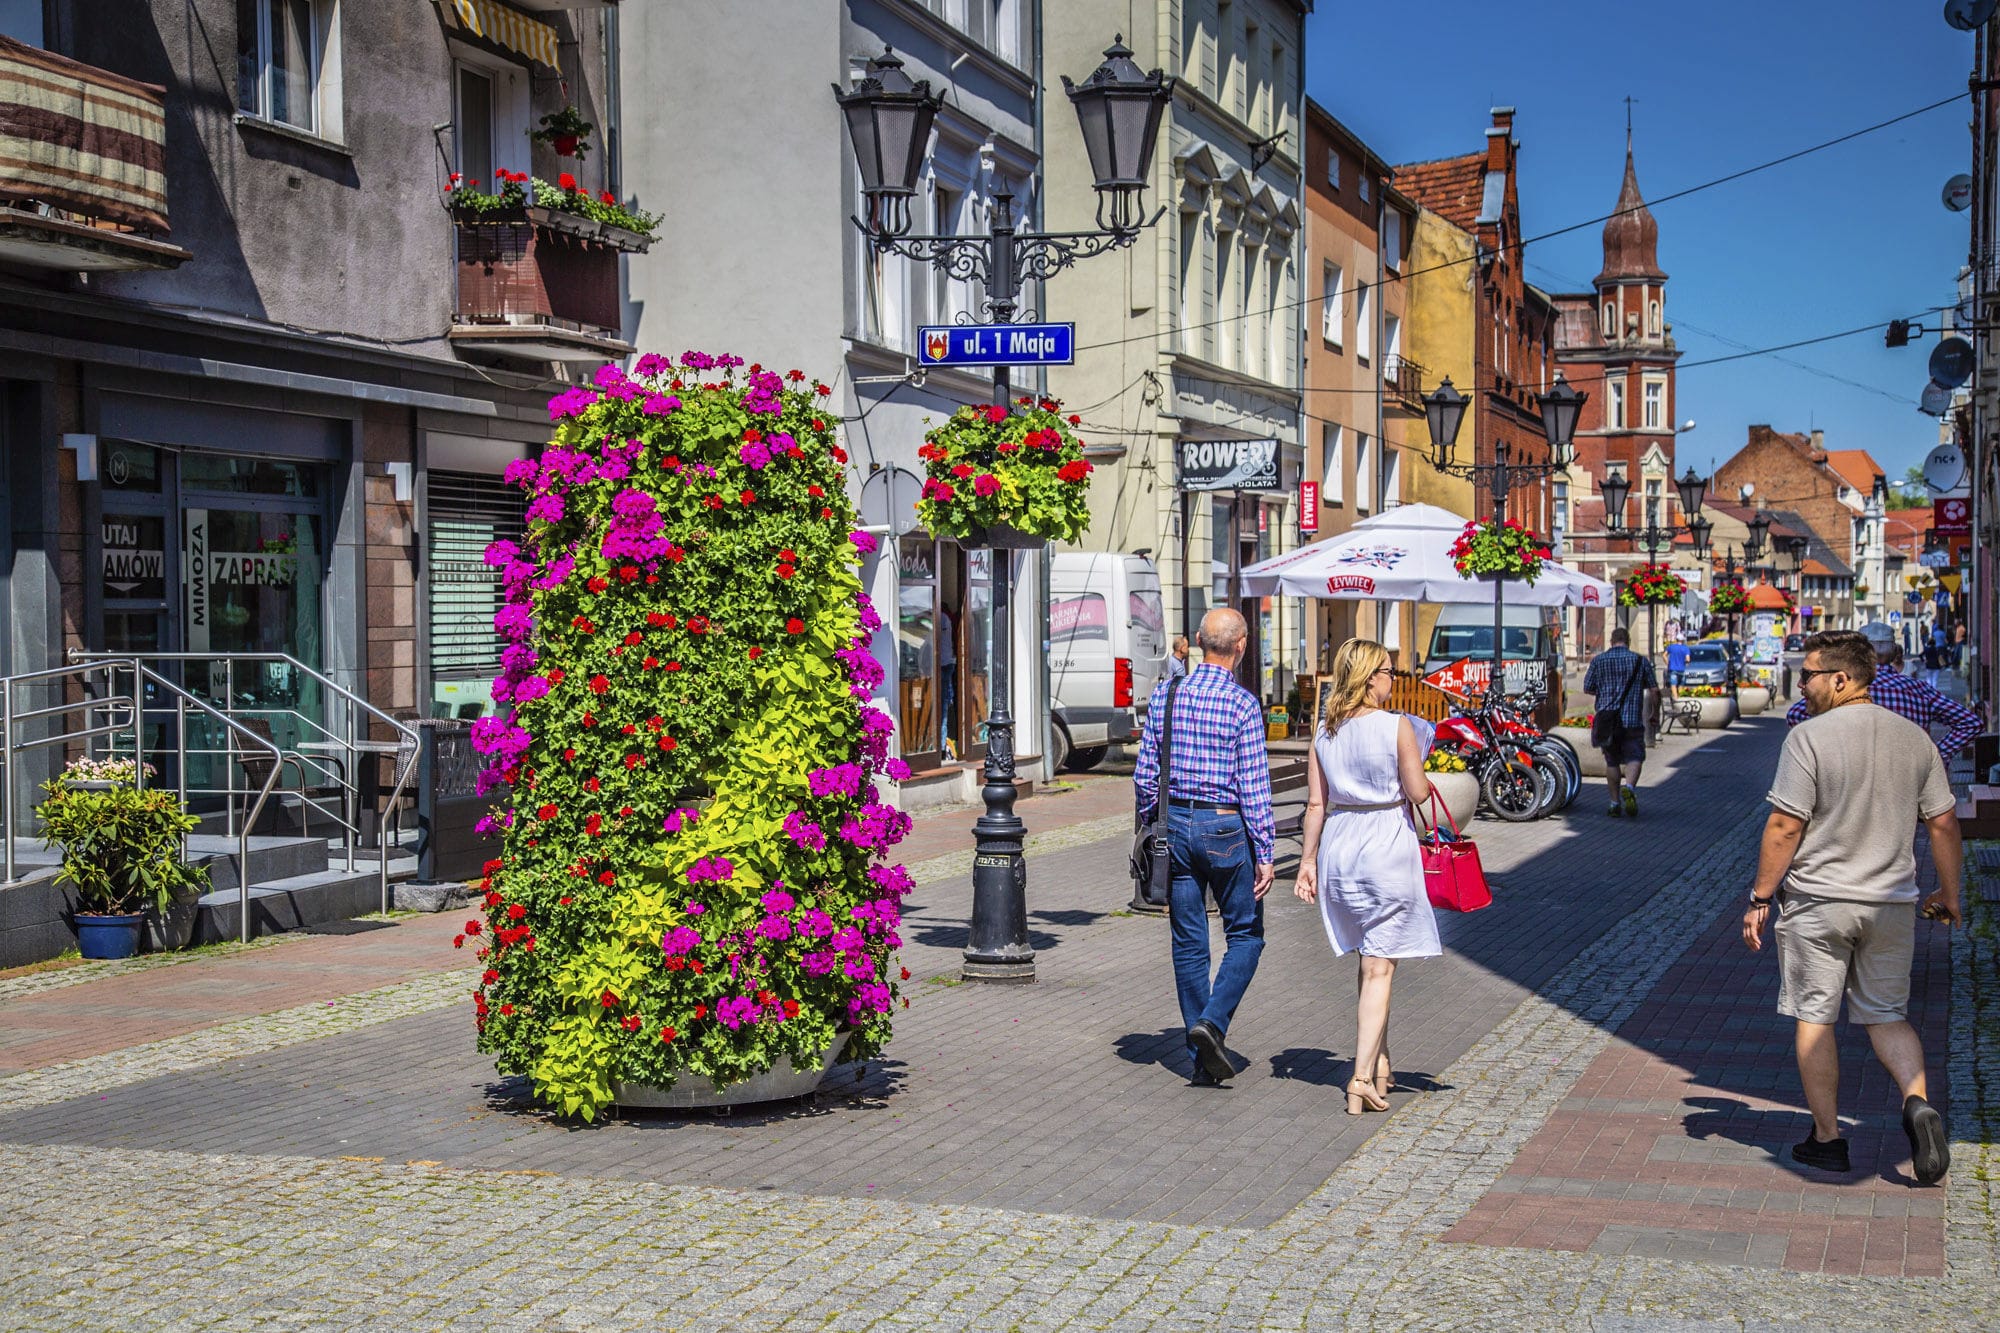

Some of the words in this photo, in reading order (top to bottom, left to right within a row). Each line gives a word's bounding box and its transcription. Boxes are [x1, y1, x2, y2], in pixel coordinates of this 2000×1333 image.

[963, 331, 987, 355] ul.
[994, 332, 1002, 354] 1
[1009, 332, 1055, 359] Maja
[1183, 440, 1277, 470] ROWERY
[1934, 455, 1956, 464] nc+
[1304, 485, 1314, 526] ŻYWIEC
[102, 524, 137, 545] UTAJ
[104, 550, 161, 579] AMÓW
[192, 523, 205, 627] MIMOZA
[1333, 576, 1370, 589] ŻYWIEC
[1463, 661, 1491, 682] SKUTE
[1506, 660, 1544, 681] ROWERY
